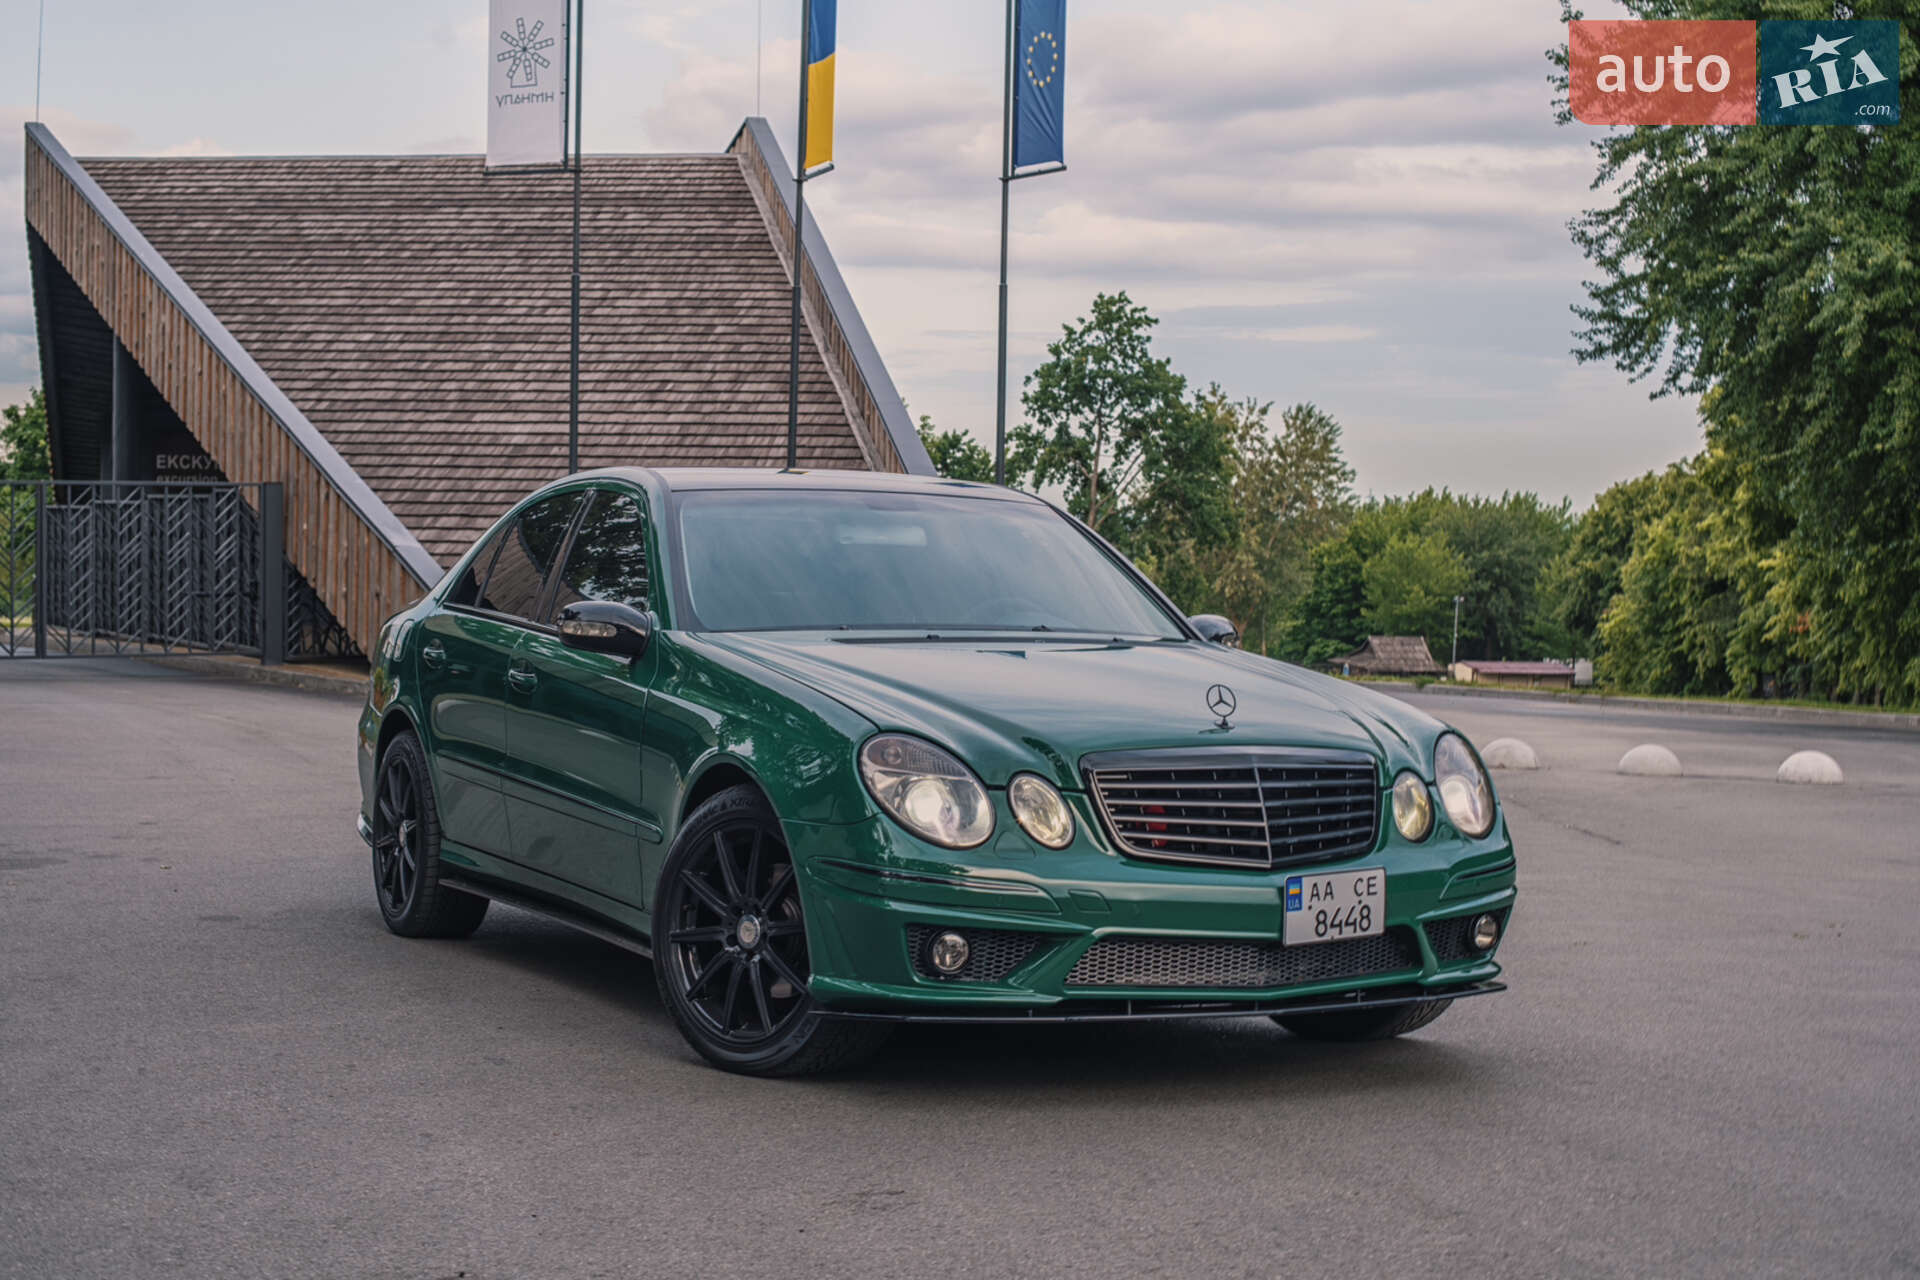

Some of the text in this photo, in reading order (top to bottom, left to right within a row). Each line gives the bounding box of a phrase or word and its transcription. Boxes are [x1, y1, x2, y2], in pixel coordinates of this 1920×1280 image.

[1310, 876, 1377, 902] AA CE
[1288, 898, 1301, 910] UA
[1315, 904, 1371, 937] 8448
